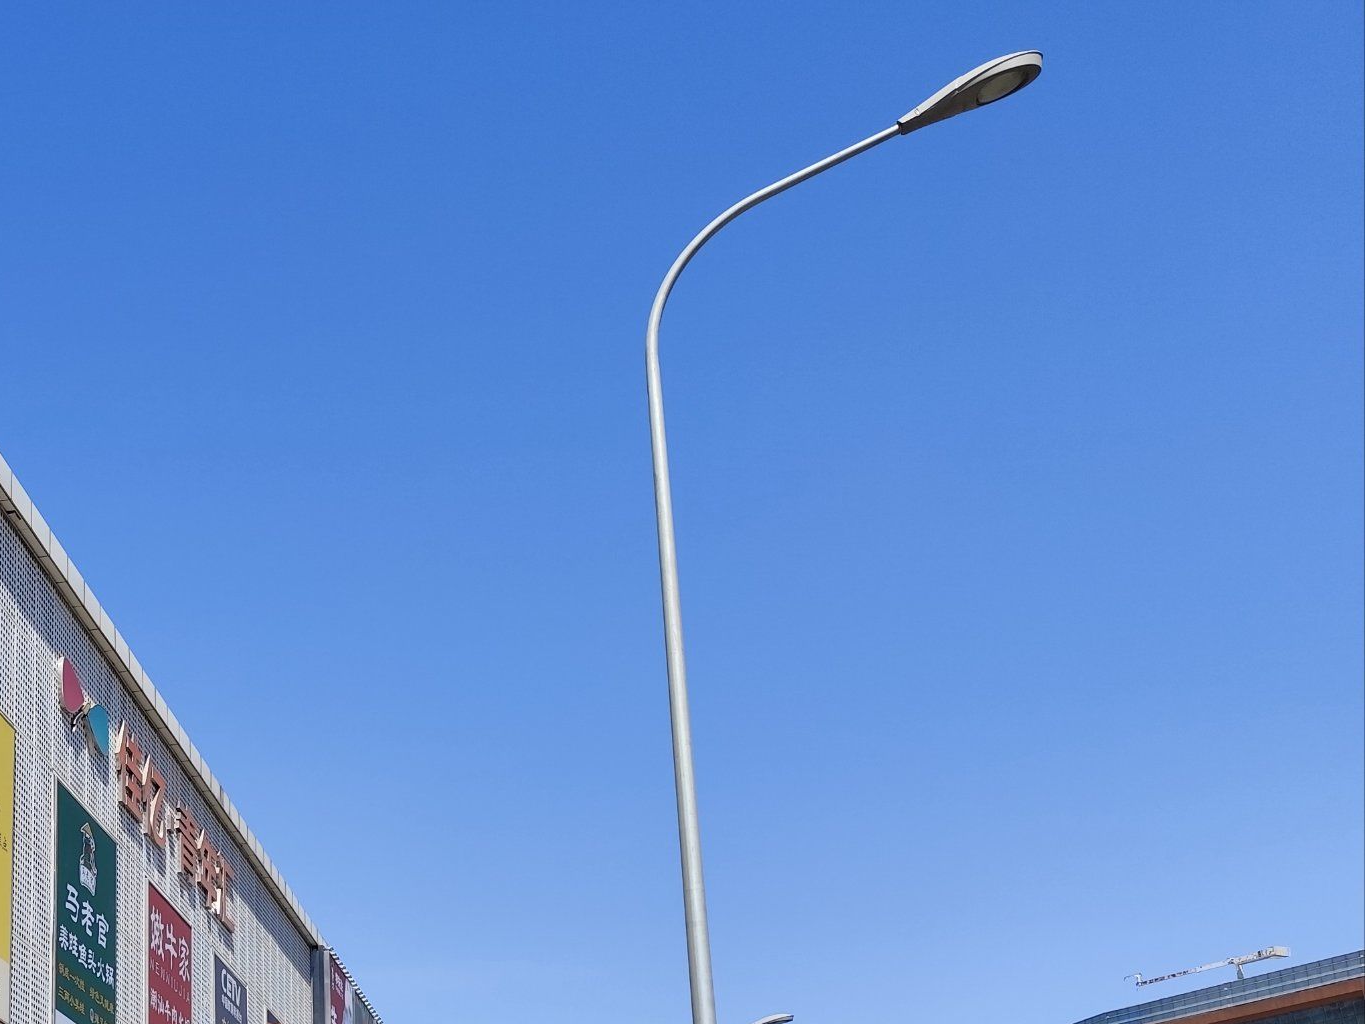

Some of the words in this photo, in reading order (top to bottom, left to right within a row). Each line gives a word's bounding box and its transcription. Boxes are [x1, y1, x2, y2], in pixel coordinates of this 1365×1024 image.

[65, 882, 110, 950] 马老官
[149, 903, 191, 983] 嫩牛家
[221, 968, 242, 1009] CETV
